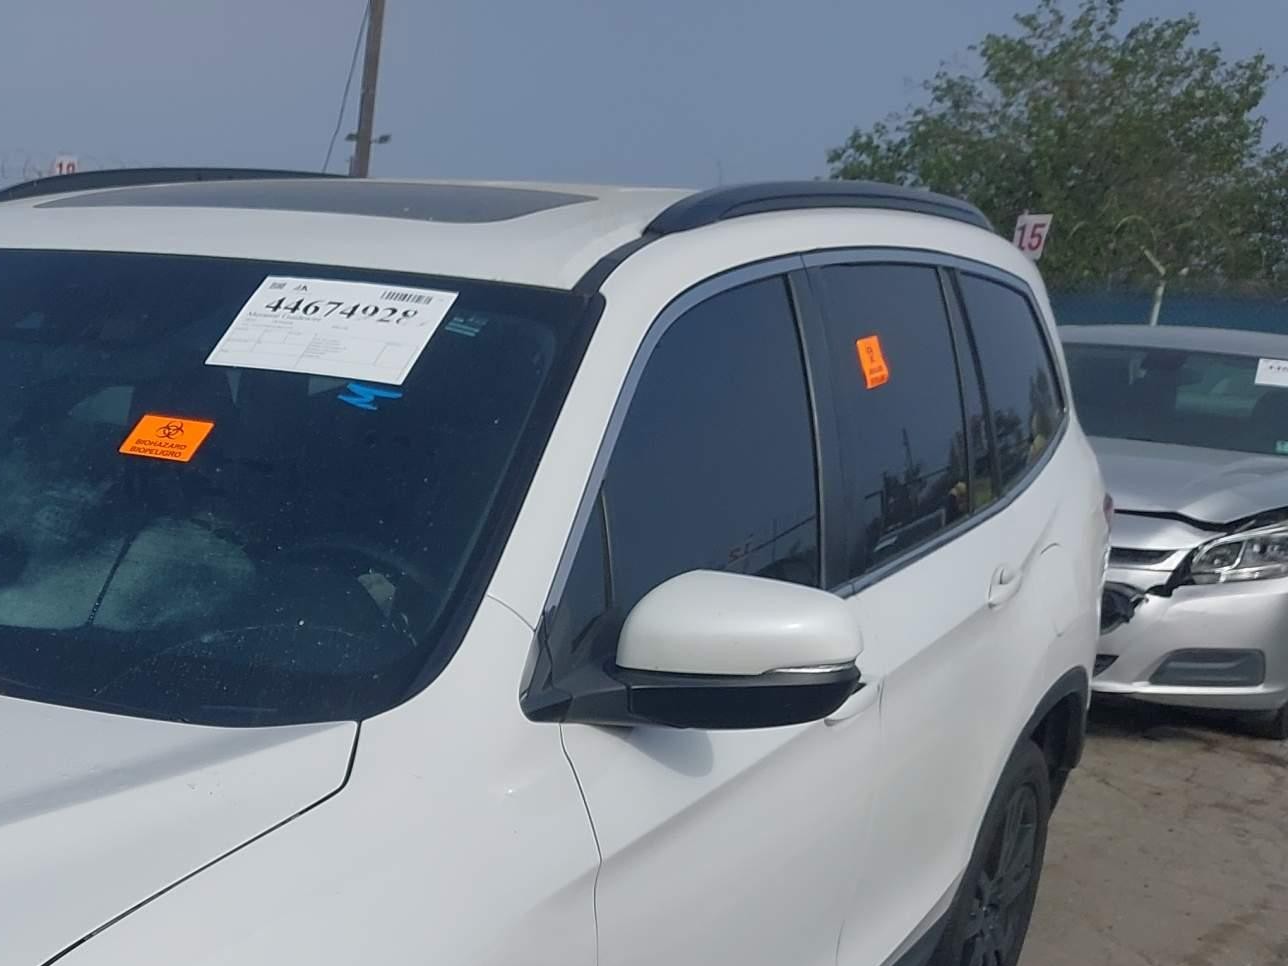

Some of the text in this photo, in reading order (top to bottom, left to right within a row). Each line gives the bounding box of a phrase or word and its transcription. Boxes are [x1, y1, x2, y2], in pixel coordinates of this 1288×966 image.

[1016, 223, 1047, 252] 15
[264, 296, 420, 325] 44674928
[129, 446, 182, 458] BIOPELIGRO
[135, 438, 188, 451] BIOHAZARD
